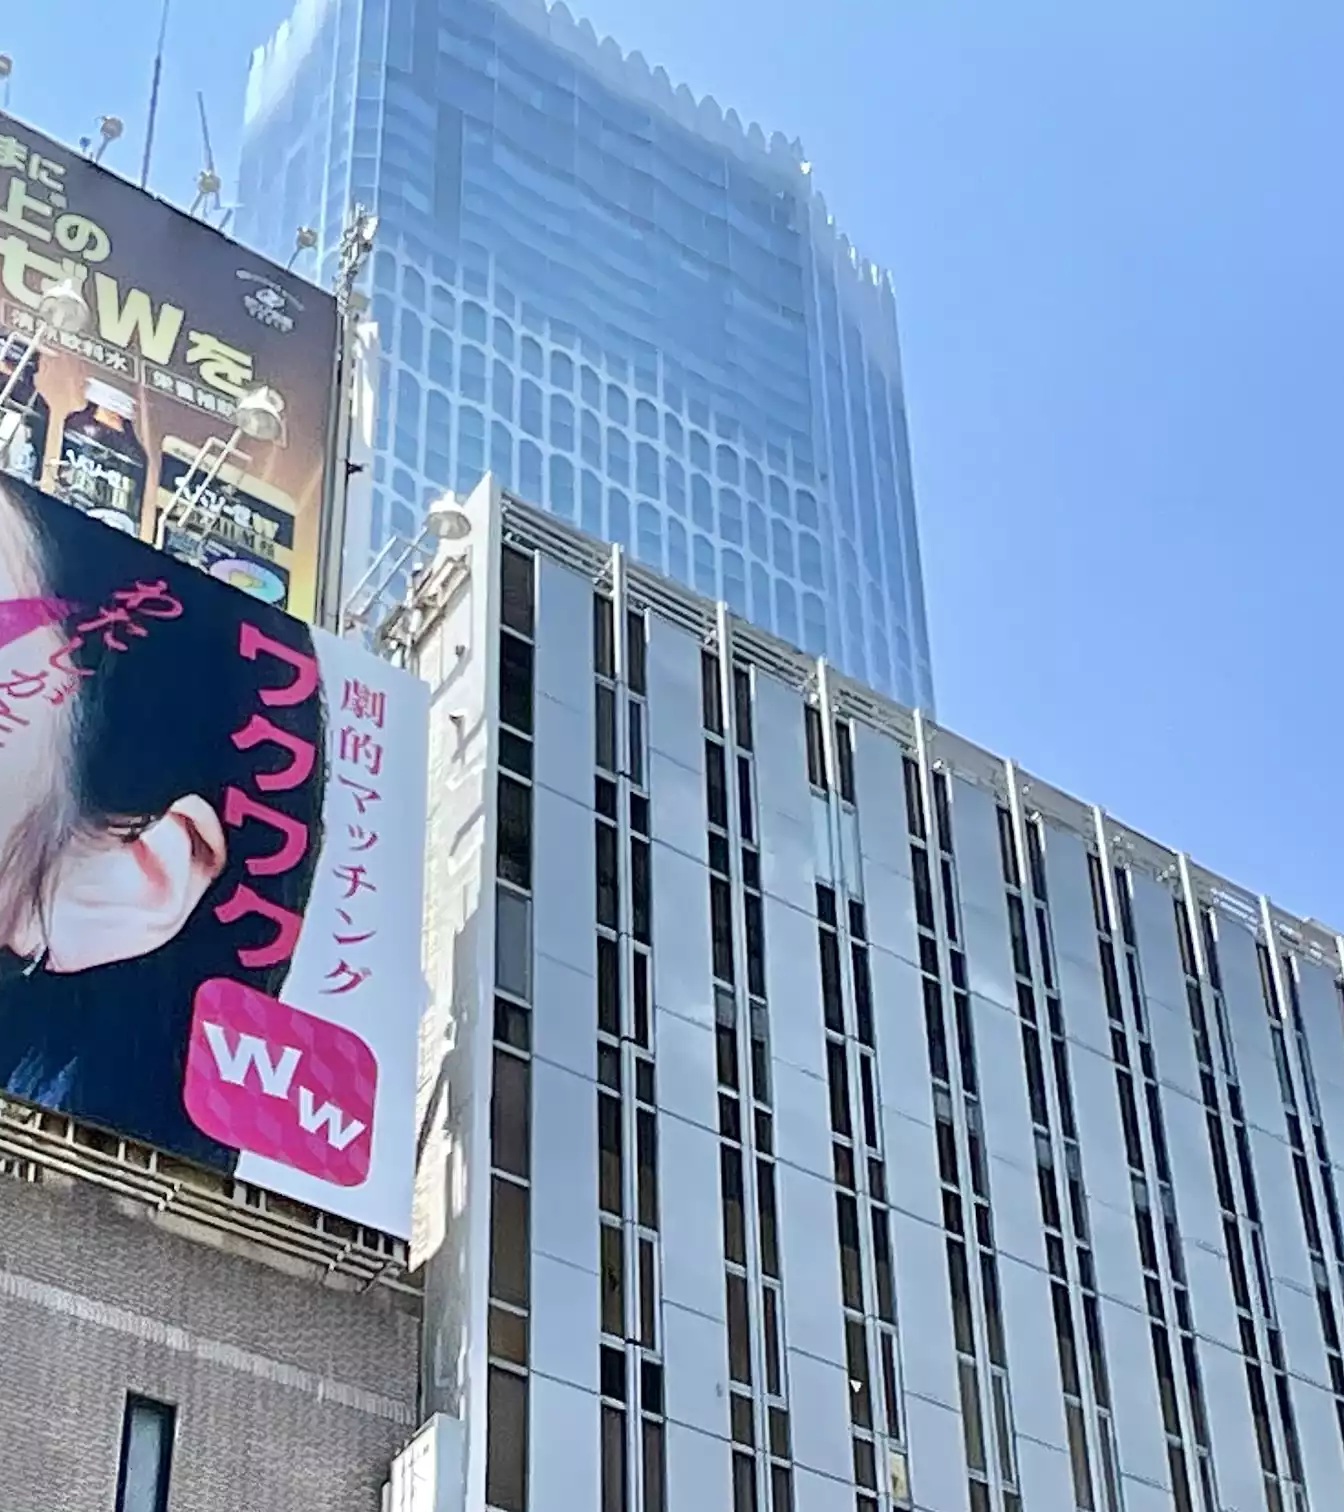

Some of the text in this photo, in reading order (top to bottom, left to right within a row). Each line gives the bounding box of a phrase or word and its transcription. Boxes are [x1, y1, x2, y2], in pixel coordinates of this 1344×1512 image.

[214, 621, 323, 969] ワクワク
[323, 677, 389, 997] 劇的マッチング
